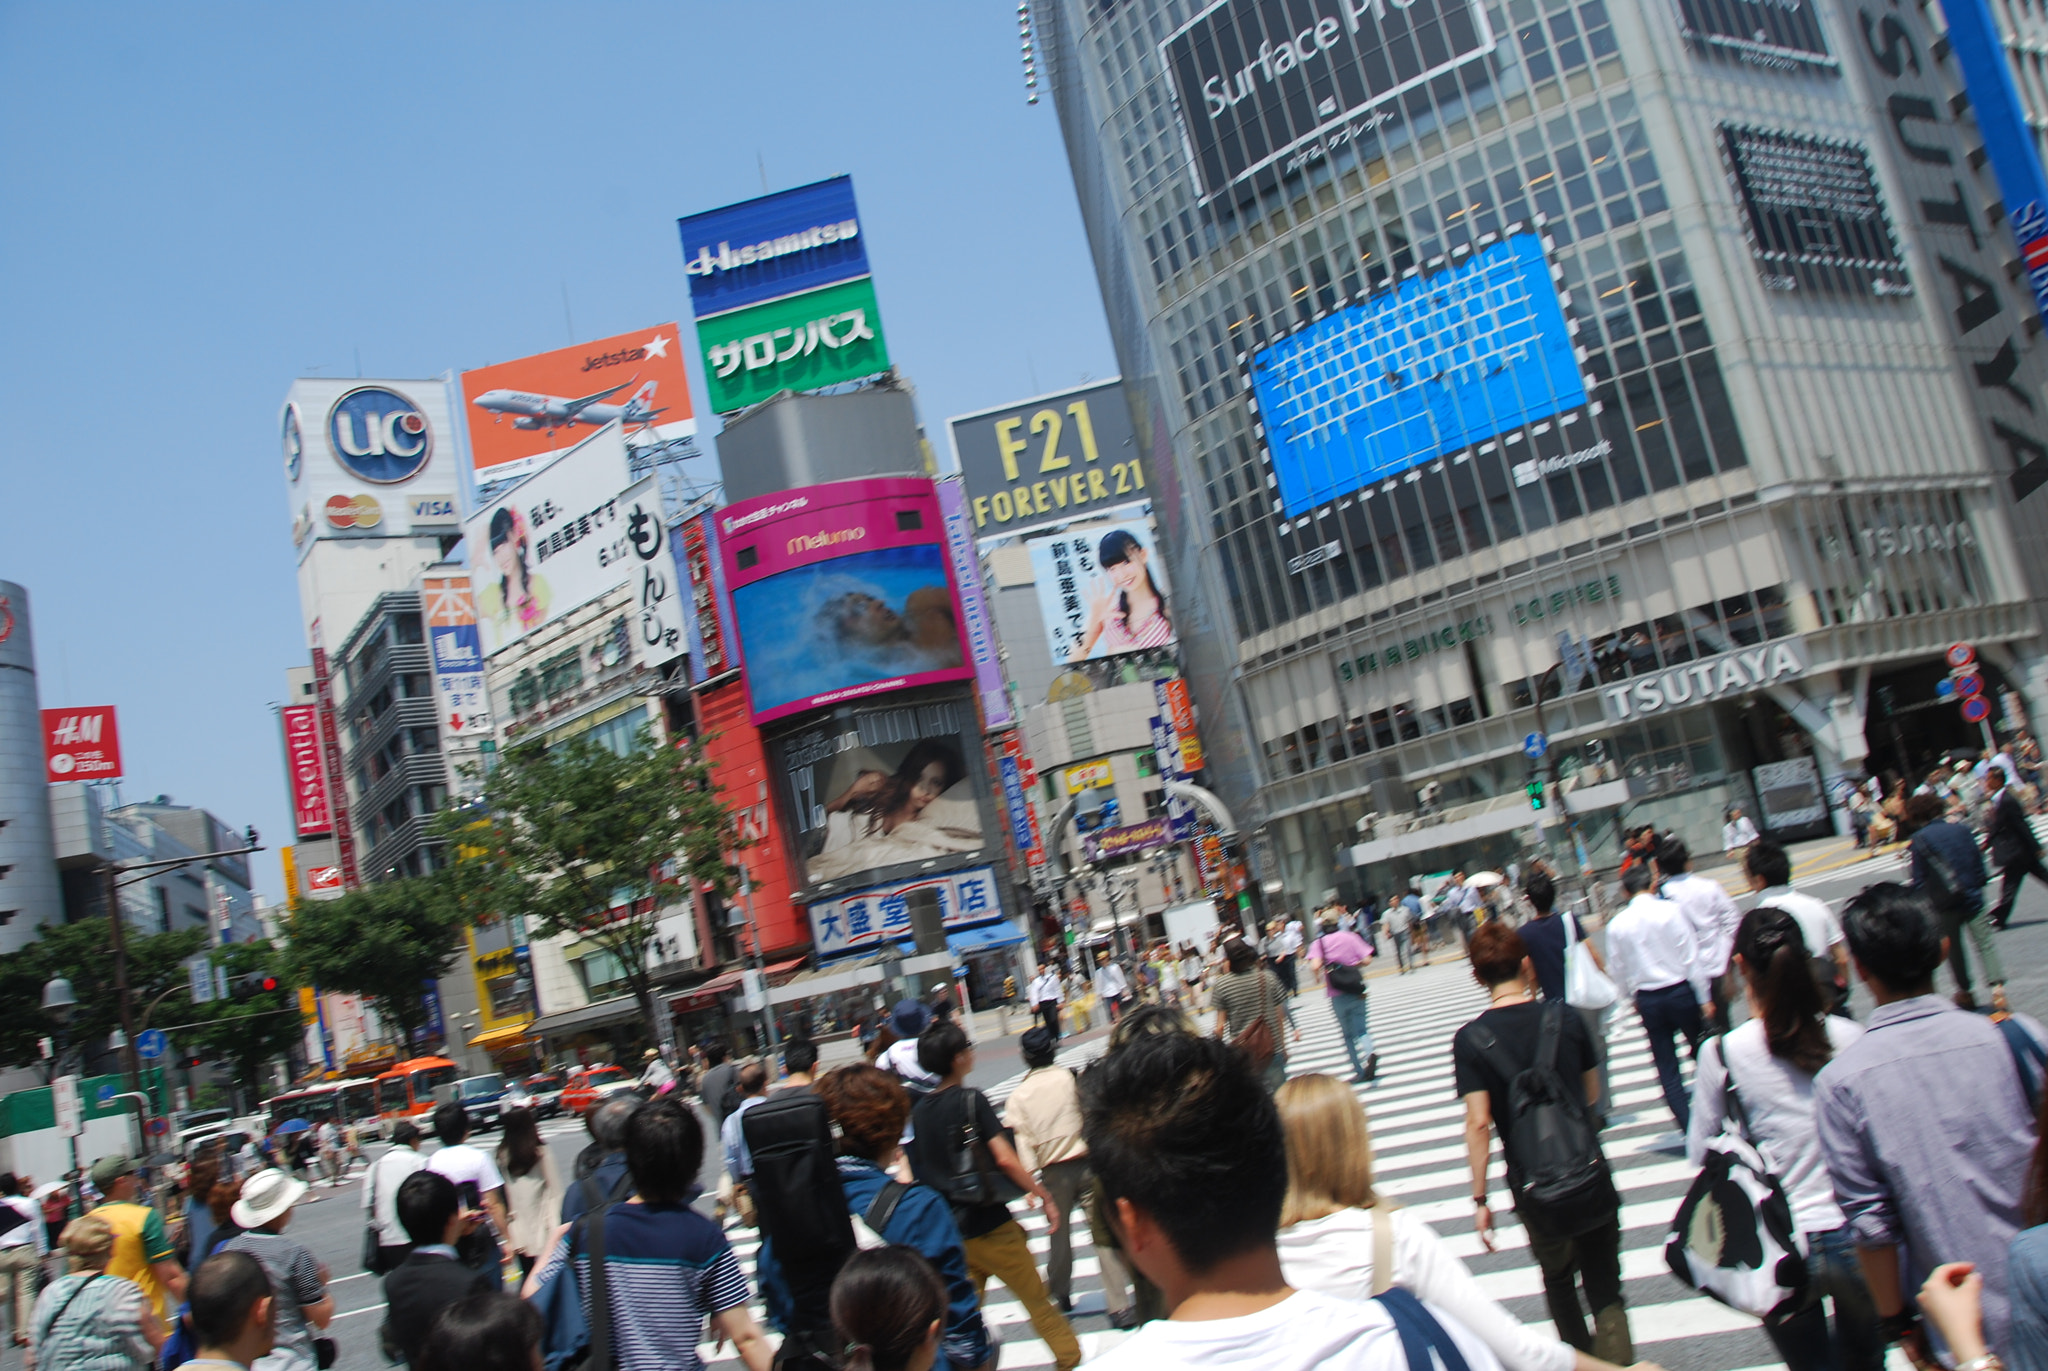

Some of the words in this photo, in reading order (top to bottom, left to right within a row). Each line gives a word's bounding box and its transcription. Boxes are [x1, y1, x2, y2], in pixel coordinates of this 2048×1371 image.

[1202, 15, 1341, 120] Surface
[684, 217, 859, 276] Hisamitsu
[1856, 0, 2048, 505] SUTAYA
[581, 346, 646, 373] Jetstar
[707, 307, 875, 379] サロンパス
[994, 399, 1099, 482] F21
[1537, 438, 1613, 476] Microsoft
[972, 467, 1110, 529] FOREVER
[1110, 458, 1146, 496] 21
[1606, 642, 1803, 719] TSUTAYA
[284, 707, 328, 829] Essential
[818, 877, 987, 945] 大盛堂店
